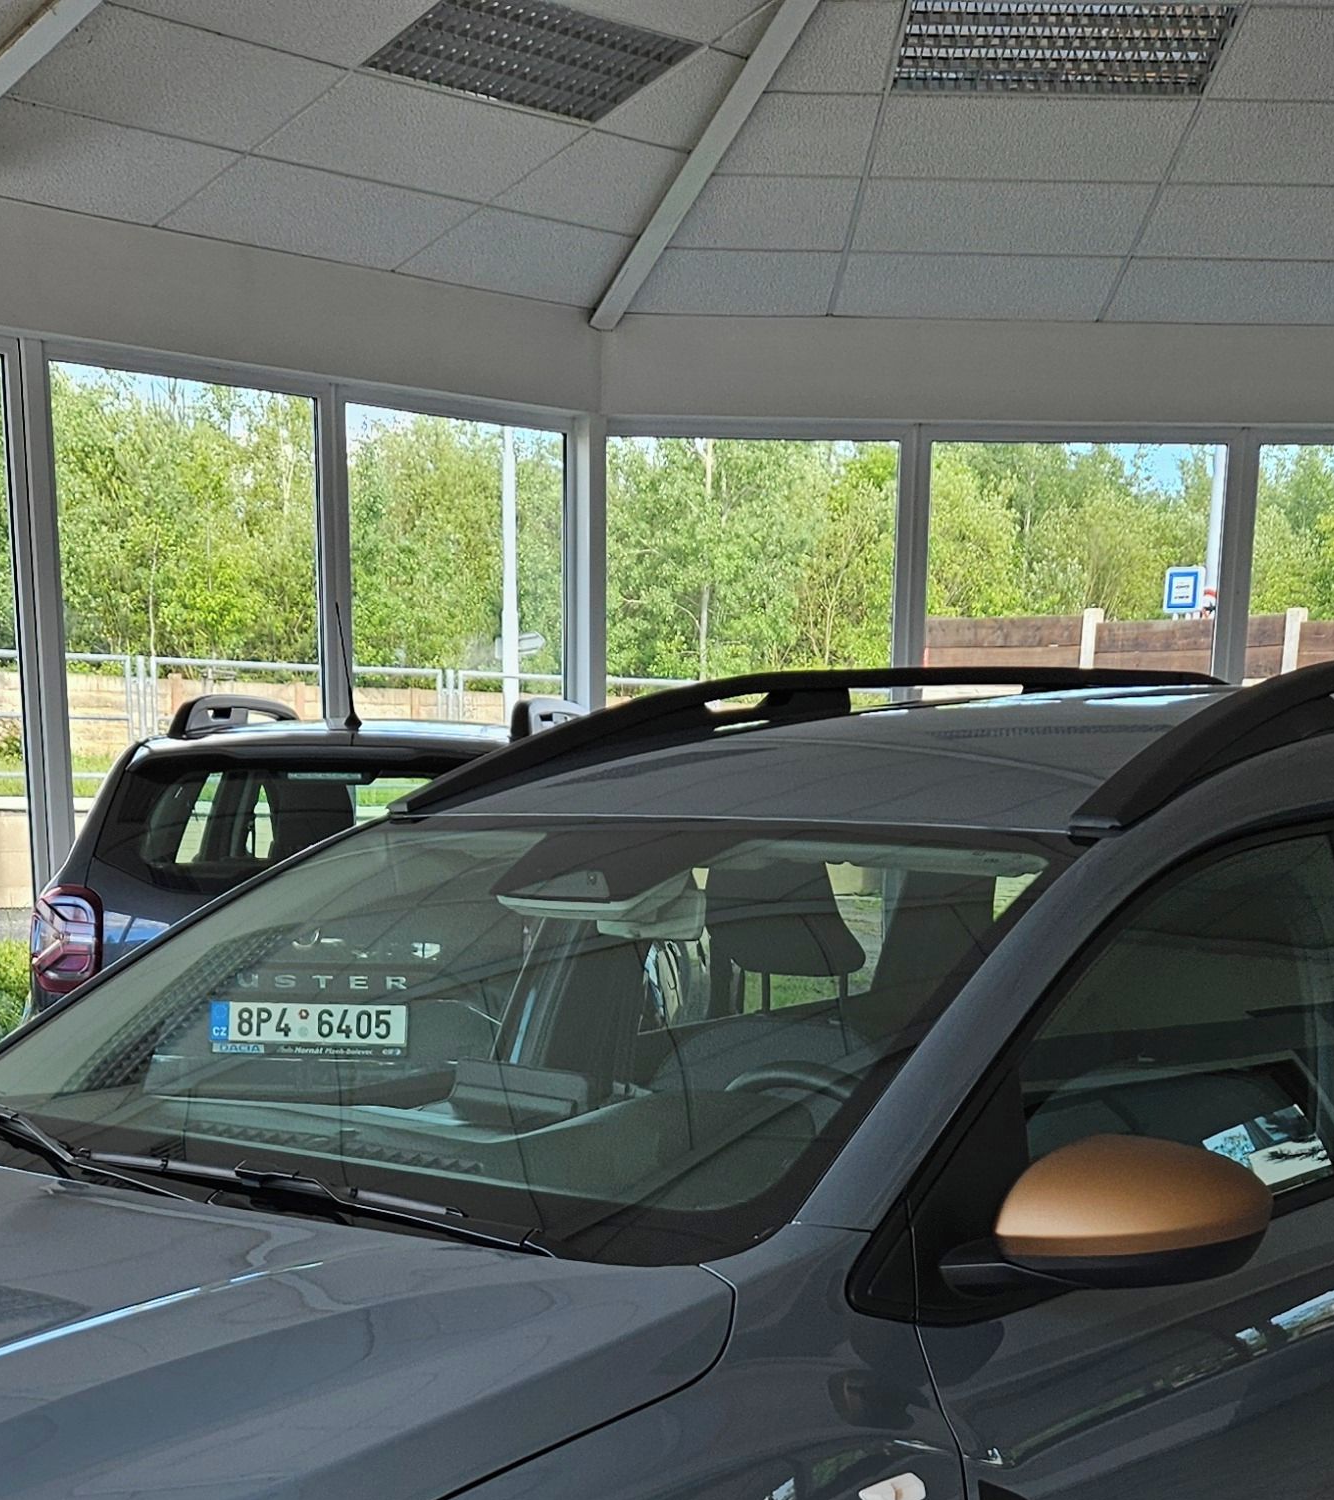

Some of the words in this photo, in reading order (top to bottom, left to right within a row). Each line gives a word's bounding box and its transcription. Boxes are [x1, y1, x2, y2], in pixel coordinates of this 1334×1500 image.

[212, 1027, 228, 1037] CZ
[237, 1007, 291, 1037] 8P4
[317, 1009, 392, 1039] 6405
